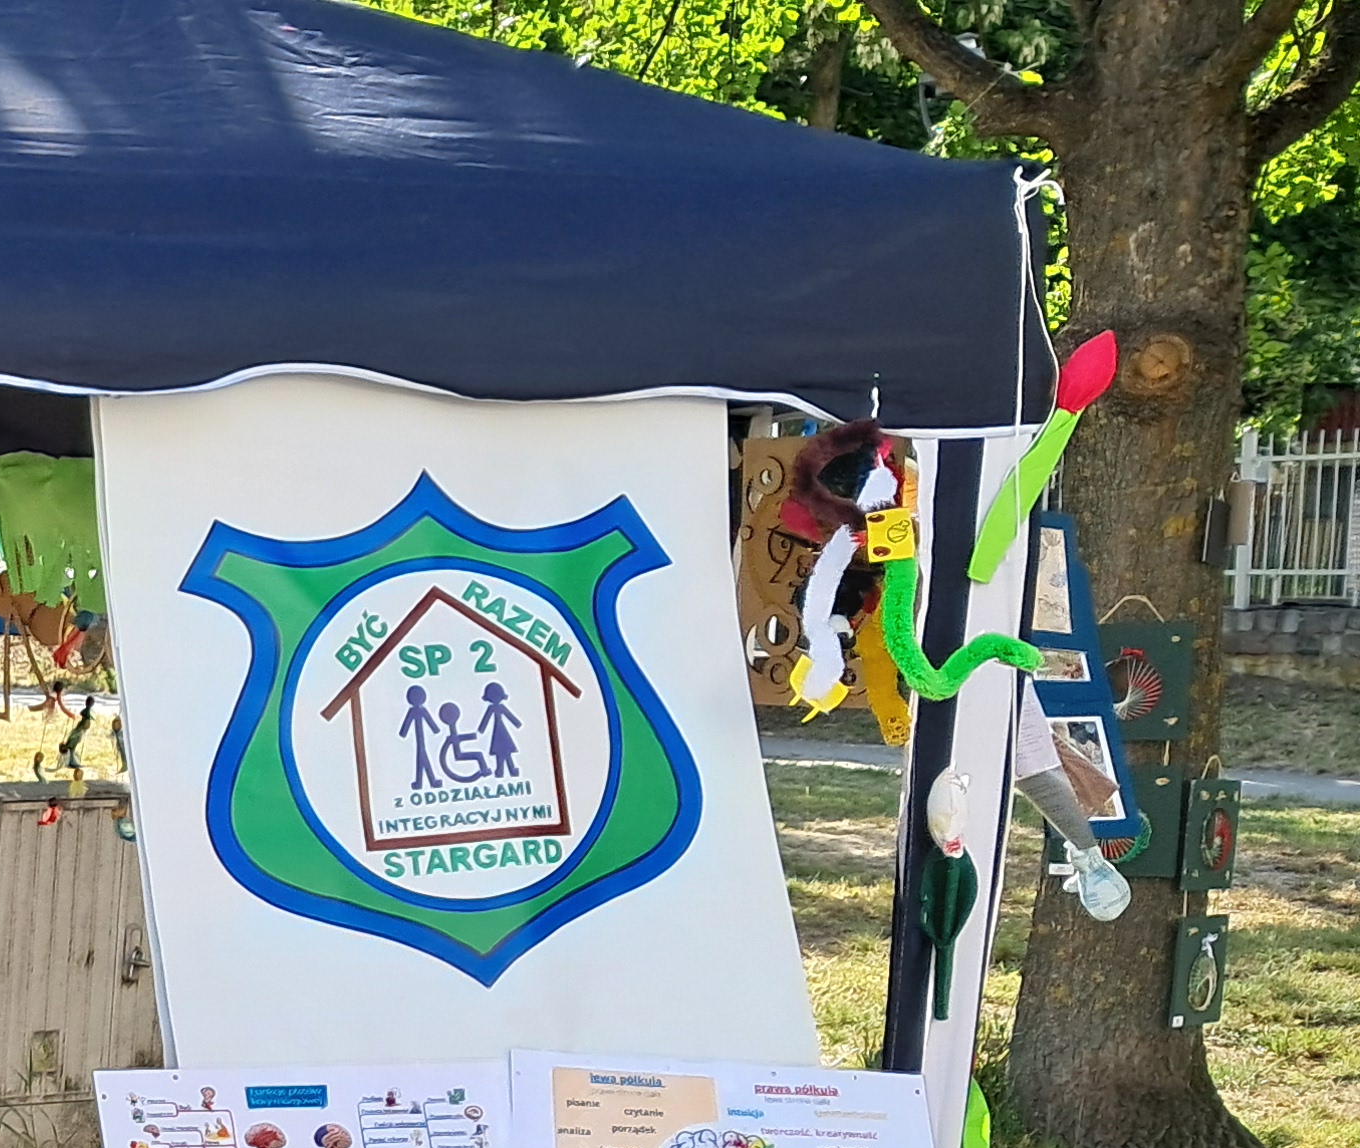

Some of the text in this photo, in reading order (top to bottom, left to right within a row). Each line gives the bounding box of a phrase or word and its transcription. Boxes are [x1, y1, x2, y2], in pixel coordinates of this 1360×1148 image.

[462, 580, 573, 667] RAZEM
[335, 609, 389, 672] BYĆ
[399, 640, 497, 678] SP 2
[410, 781, 532, 806] ODDZIAŁAMI
[379, 805, 552, 834] INTEGRACYJNYMI
[384, 839, 563, 878] STARGARD
[590, 1073, 617, 1084] lewa
[754, 1084, 791, 1094] prawa
[566, 1099, 600, 1107] pisanie
[624, 1109, 664, 1118] czytanie
[612, 1126, 656, 1134] porządek
